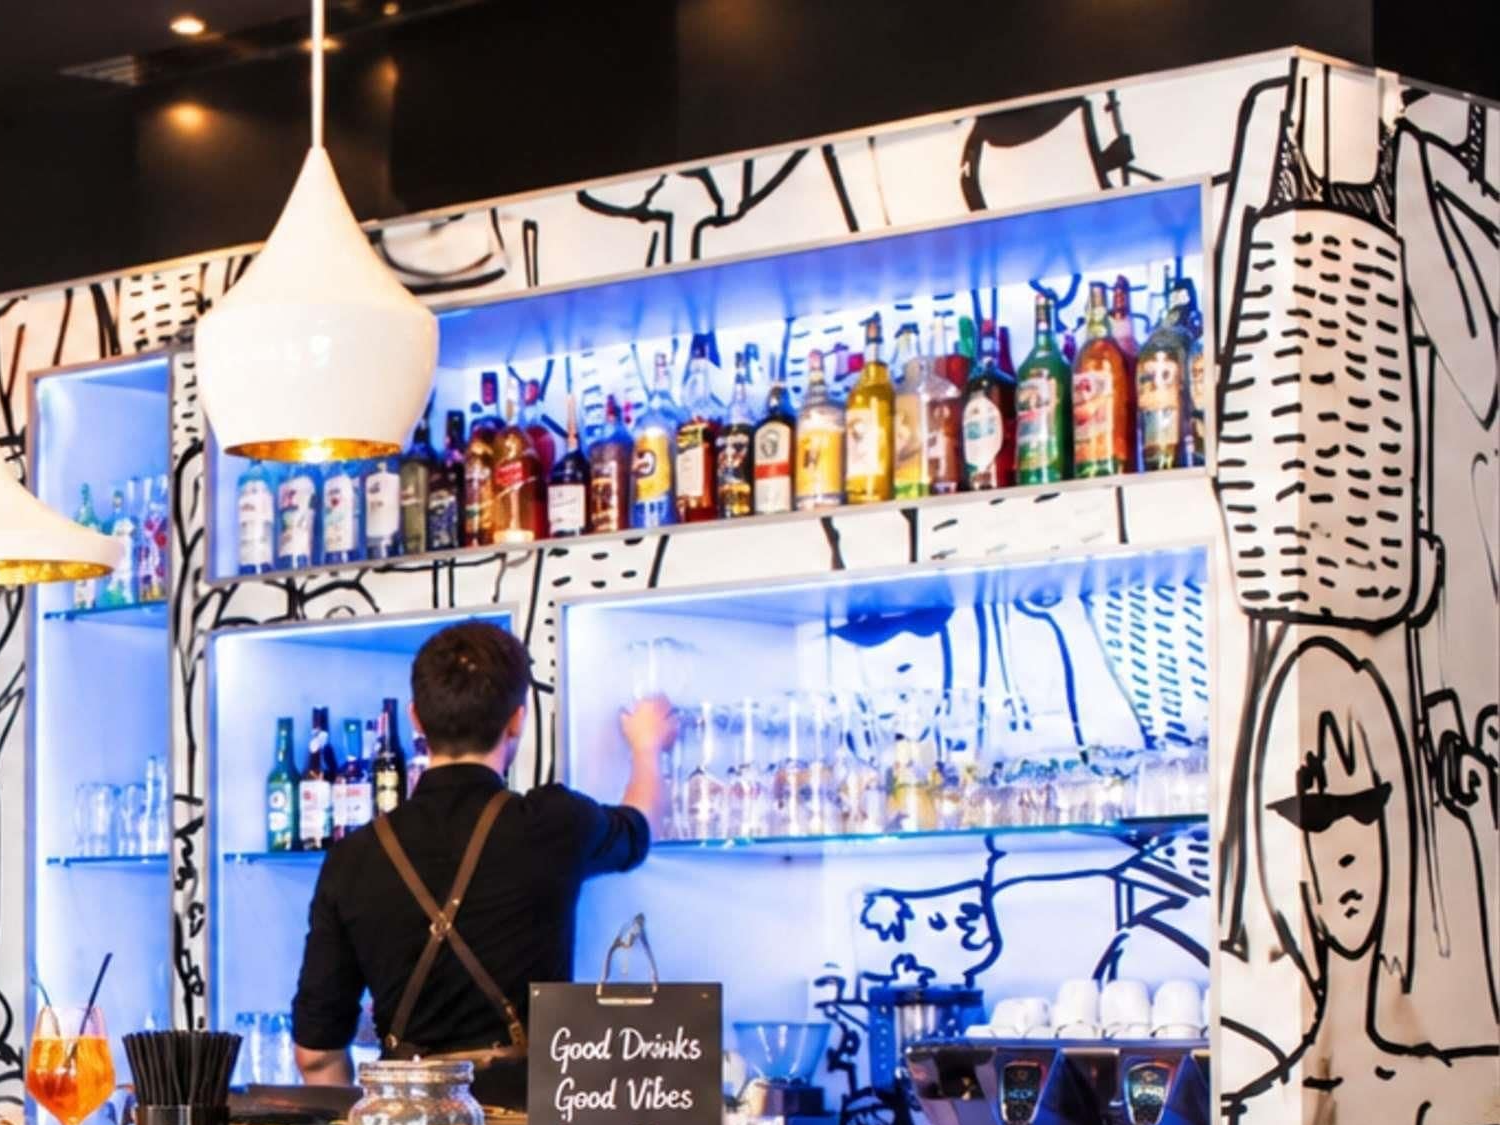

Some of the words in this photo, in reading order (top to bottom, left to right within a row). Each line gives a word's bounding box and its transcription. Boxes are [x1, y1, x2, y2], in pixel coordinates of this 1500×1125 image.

[550, 1026, 613, 1074] Good
[619, 1026, 702, 1061] Drinks
[554, 1076, 617, 1122] Good
[626, 1075, 693, 1111] Vibes
